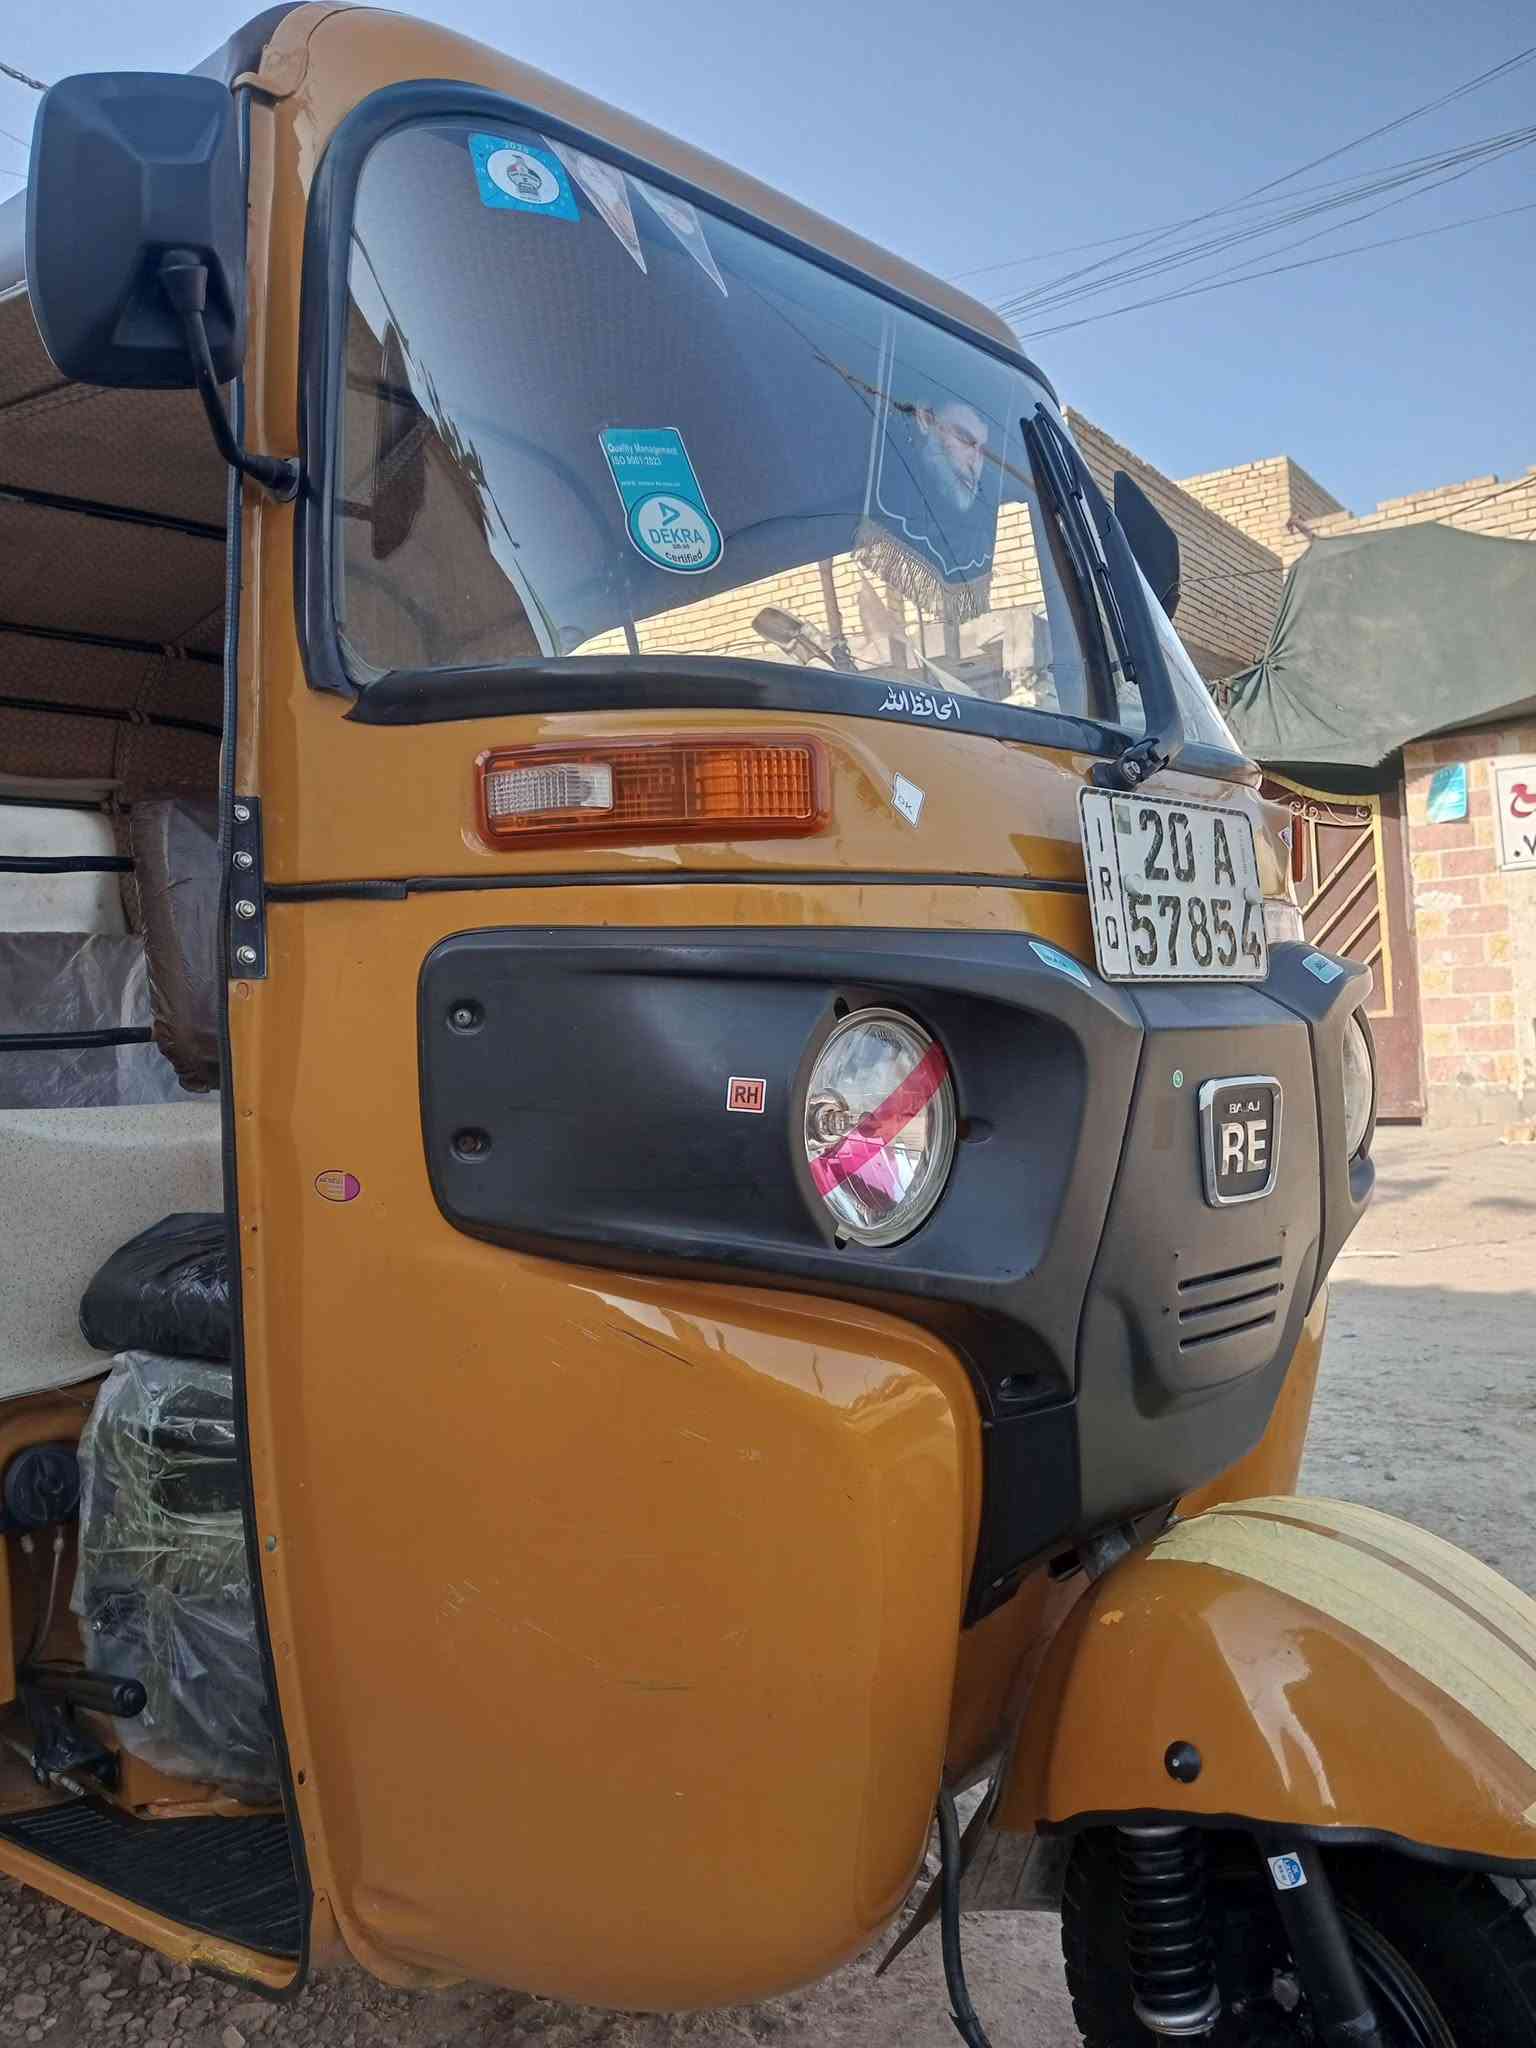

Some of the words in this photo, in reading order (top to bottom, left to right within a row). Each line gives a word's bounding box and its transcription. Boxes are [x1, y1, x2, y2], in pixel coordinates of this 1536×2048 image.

[648, 528, 705, 545] DEKRA
[1138, 808, 1196, 883] 20
[1213, 817, 1236, 888] A
[1127, 887, 1263, 970] 57854
[734, 1085, 760, 1105] RH
[1220, 1118, 1268, 1176] RE
